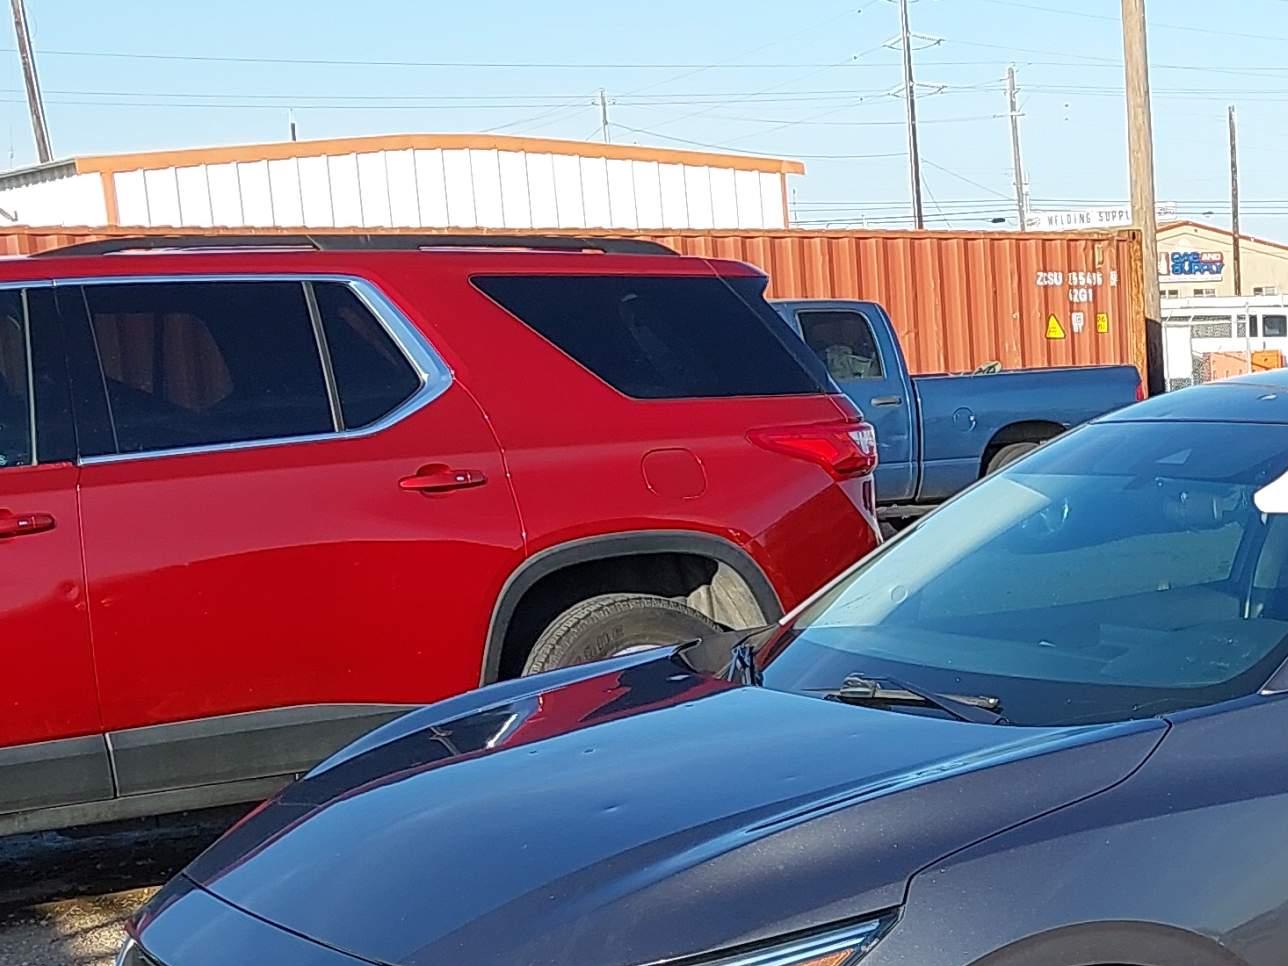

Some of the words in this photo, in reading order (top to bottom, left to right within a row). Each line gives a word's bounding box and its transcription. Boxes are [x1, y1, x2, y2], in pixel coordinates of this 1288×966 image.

[1047, 212, 1091, 226] WELDING
[1098, 209, 1130, 222] SUPPL
[1171, 262, 1224, 275] SUPPLY
